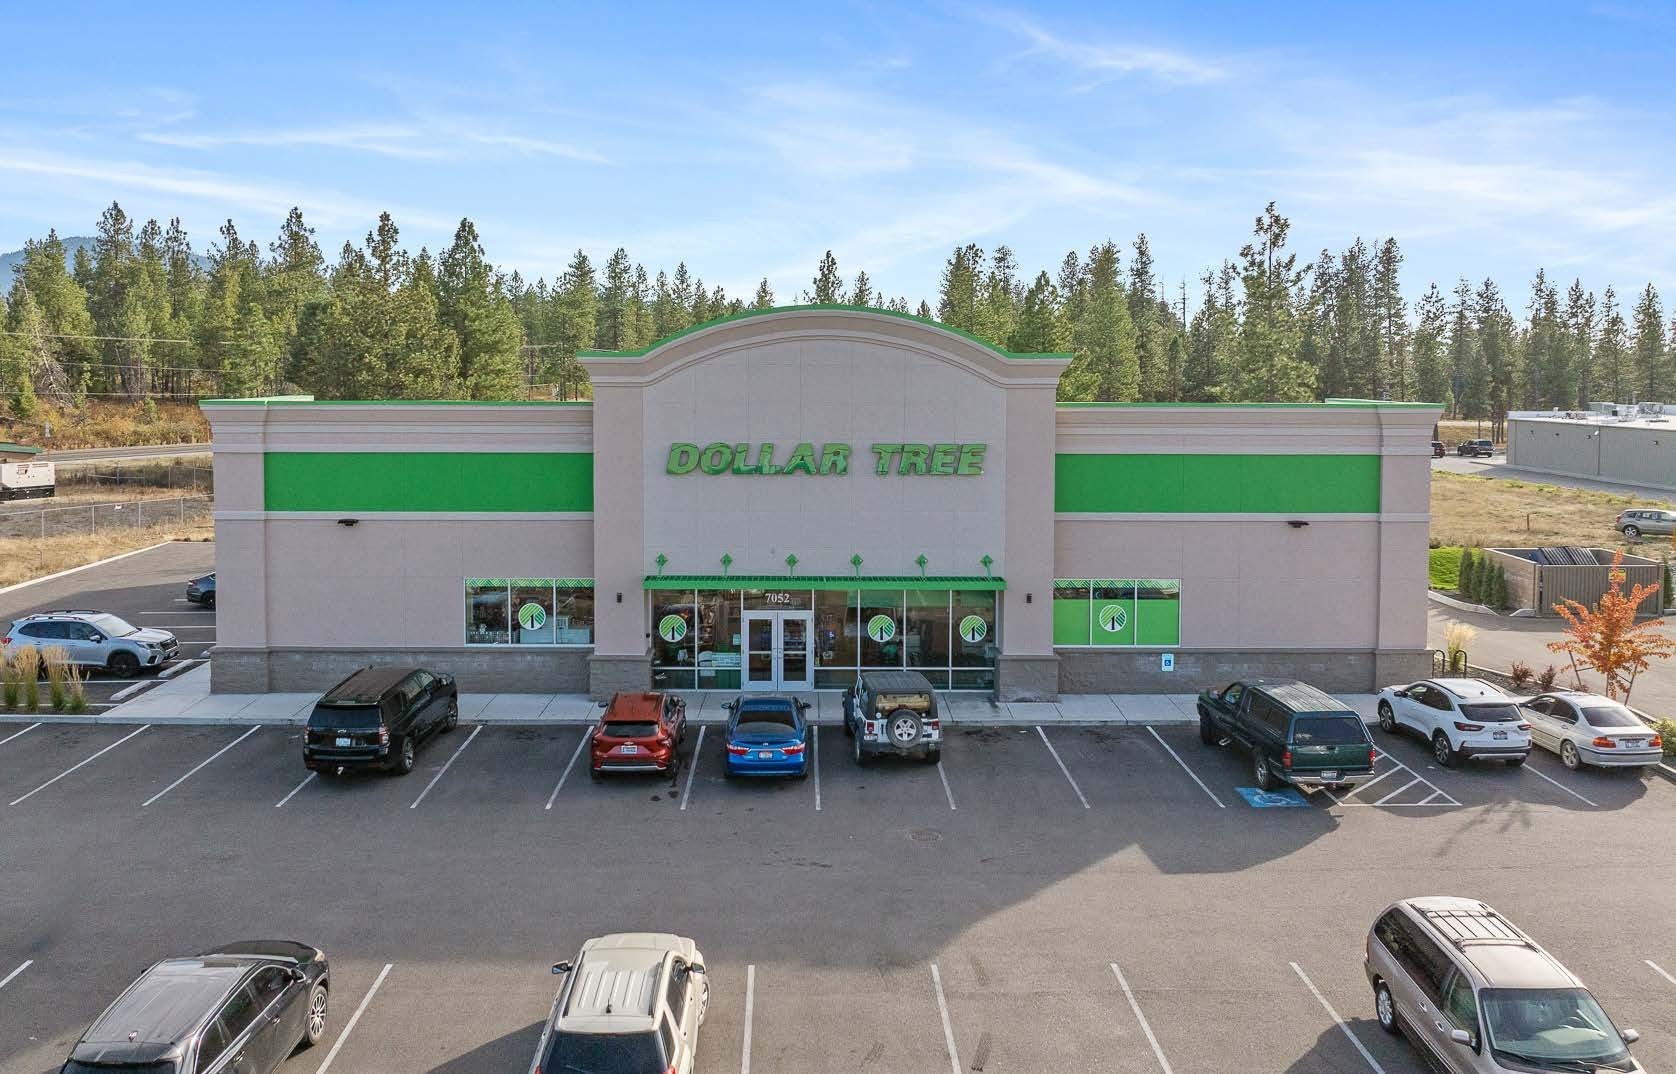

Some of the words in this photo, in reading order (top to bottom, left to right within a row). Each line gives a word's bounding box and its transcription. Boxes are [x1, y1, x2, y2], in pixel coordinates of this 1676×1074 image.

[666, 442, 851, 475] DOLLAR
[872, 443, 987, 475] TREE
[765, 593, 790, 603] 7052
